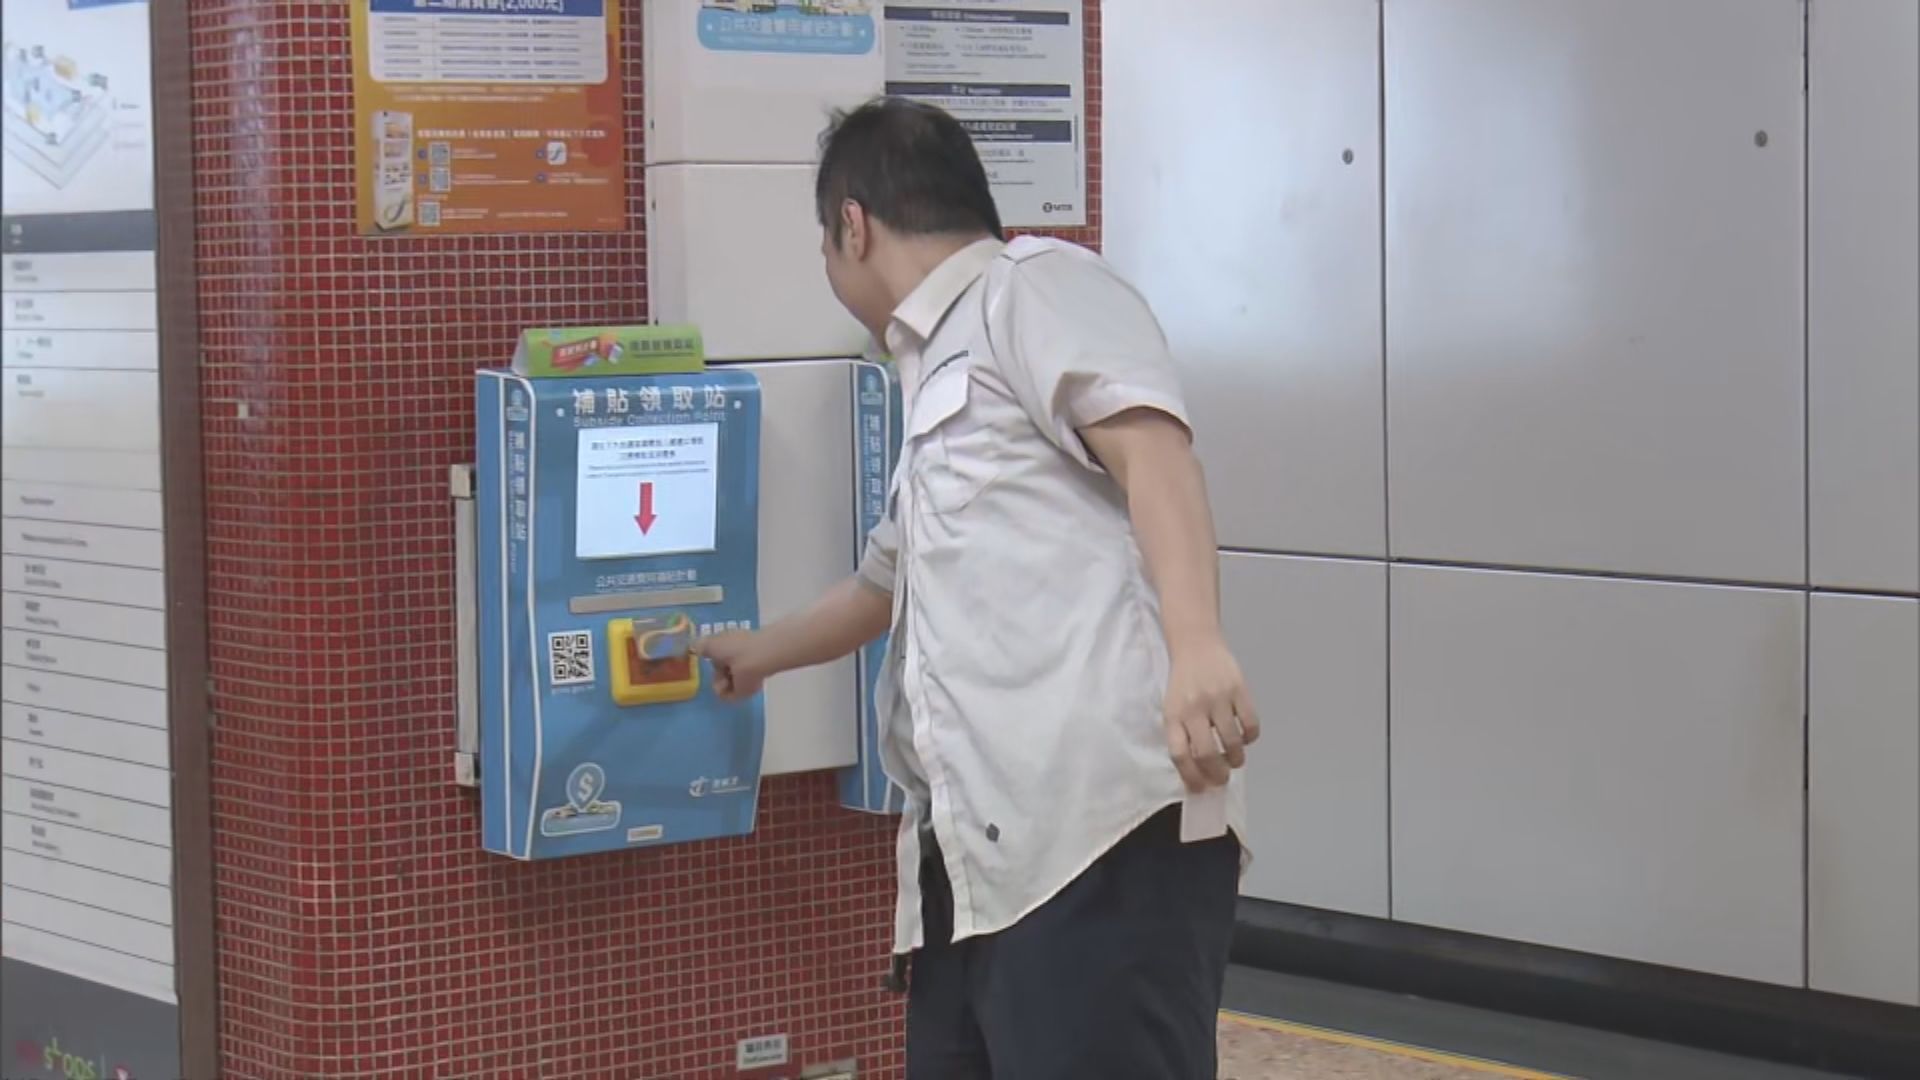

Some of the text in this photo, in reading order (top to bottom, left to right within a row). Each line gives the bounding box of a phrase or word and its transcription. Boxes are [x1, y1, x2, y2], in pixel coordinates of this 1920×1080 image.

[572, 384, 727, 416] 補貼領取站
[627, 412, 691, 426] Collection
